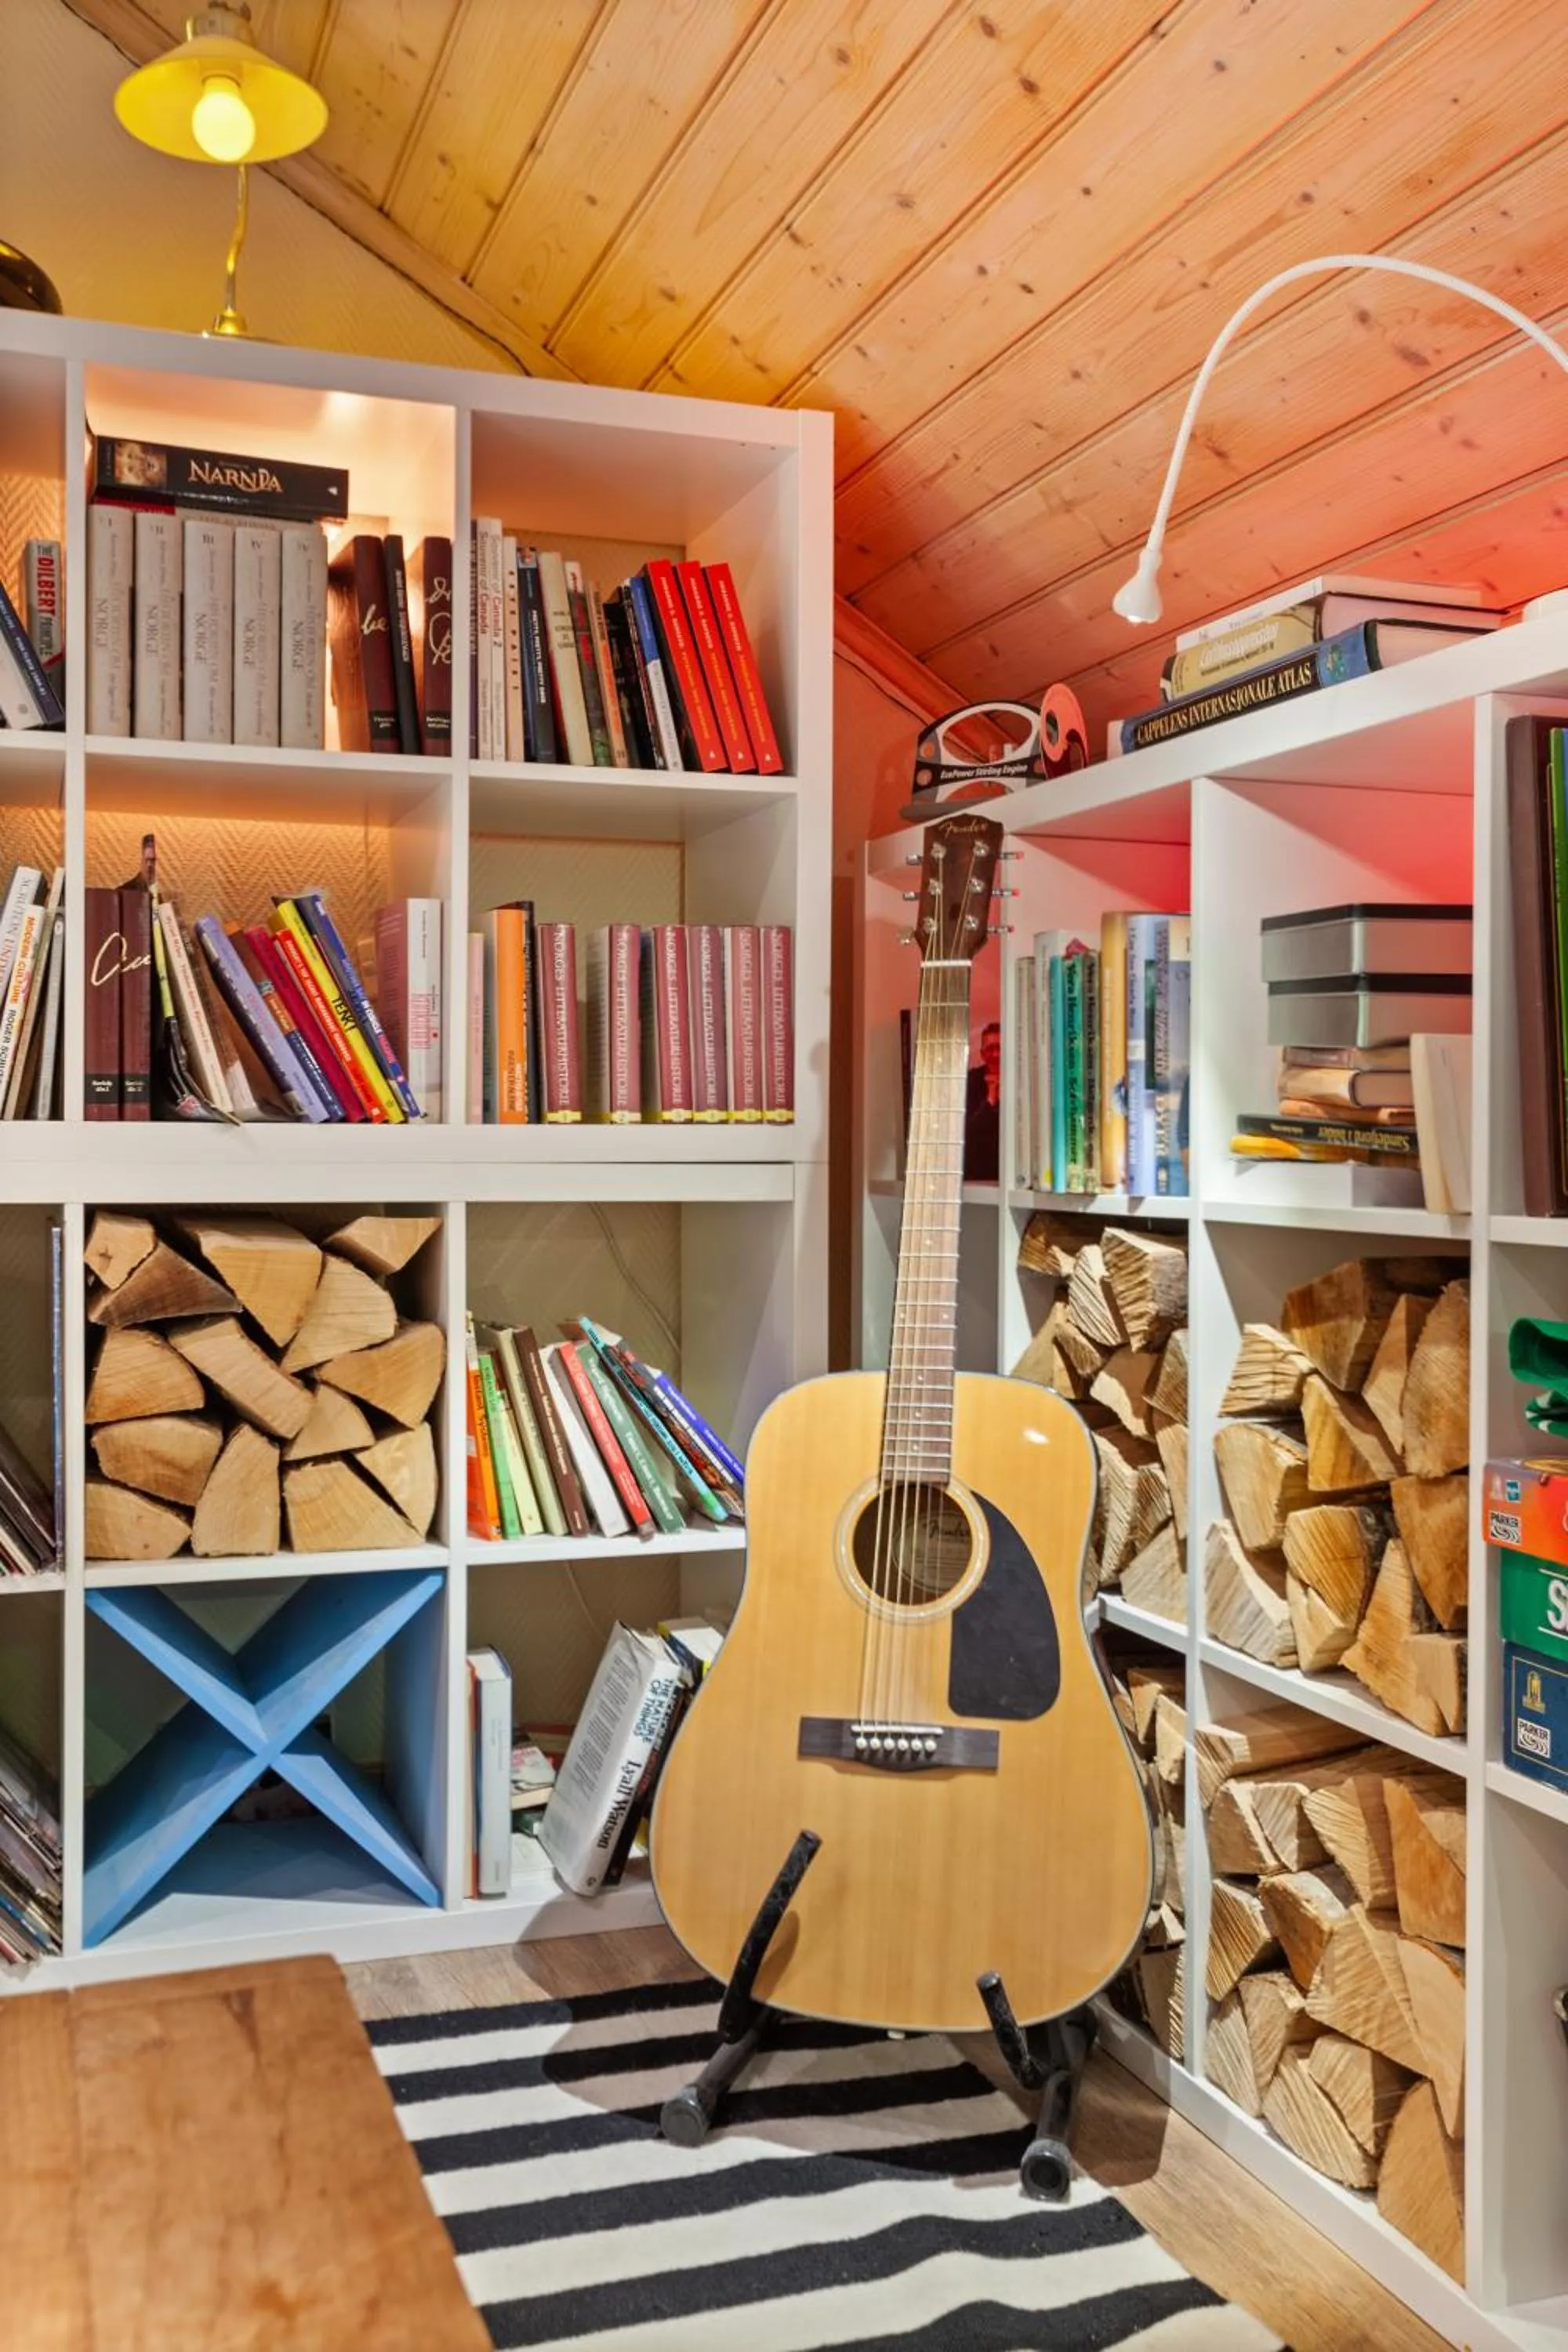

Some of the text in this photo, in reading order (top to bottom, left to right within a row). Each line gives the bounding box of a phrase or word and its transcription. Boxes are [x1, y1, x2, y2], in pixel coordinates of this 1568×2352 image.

[37, 557, 56, 617] DILBERT
[96, 597, 108, 647] NORGE
[145, 605, 158, 655] NORGE
[481, 593, 490, 634] Canada
[492, 596, 503, 637] Canada
[194, 612, 208, 665] NORGE
[242, 619, 256, 667] NORGE
[292, 620, 305, 669] NORGE
[493, 640, 503, 648] 2
[1137, 662, 1312, 744] CAPPELENS INTERNASJONALE ATLAS
[1003, 764, 1029, 775] Engine
[938, 818, 988, 840] Fender
[10, 916, 36, 1004] MODERN CULTURE
[554, 930, 566, 981] NORGES
[666, 930, 677, 982] NORGES
[739, 931, 753, 982] NORGES
[2, 1009, 16, 1044] ROGER
[1490, 1512, 1519, 1528] PARKER
[644, 1678, 673, 1743] THE NATURE
[649, 1679, 662, 1695] OF
[1519, 1720, 1549, 1740] PARKER
[616, 1759, 643, 1797] Lyall
[597, 1795, 627, 1849] Watson
